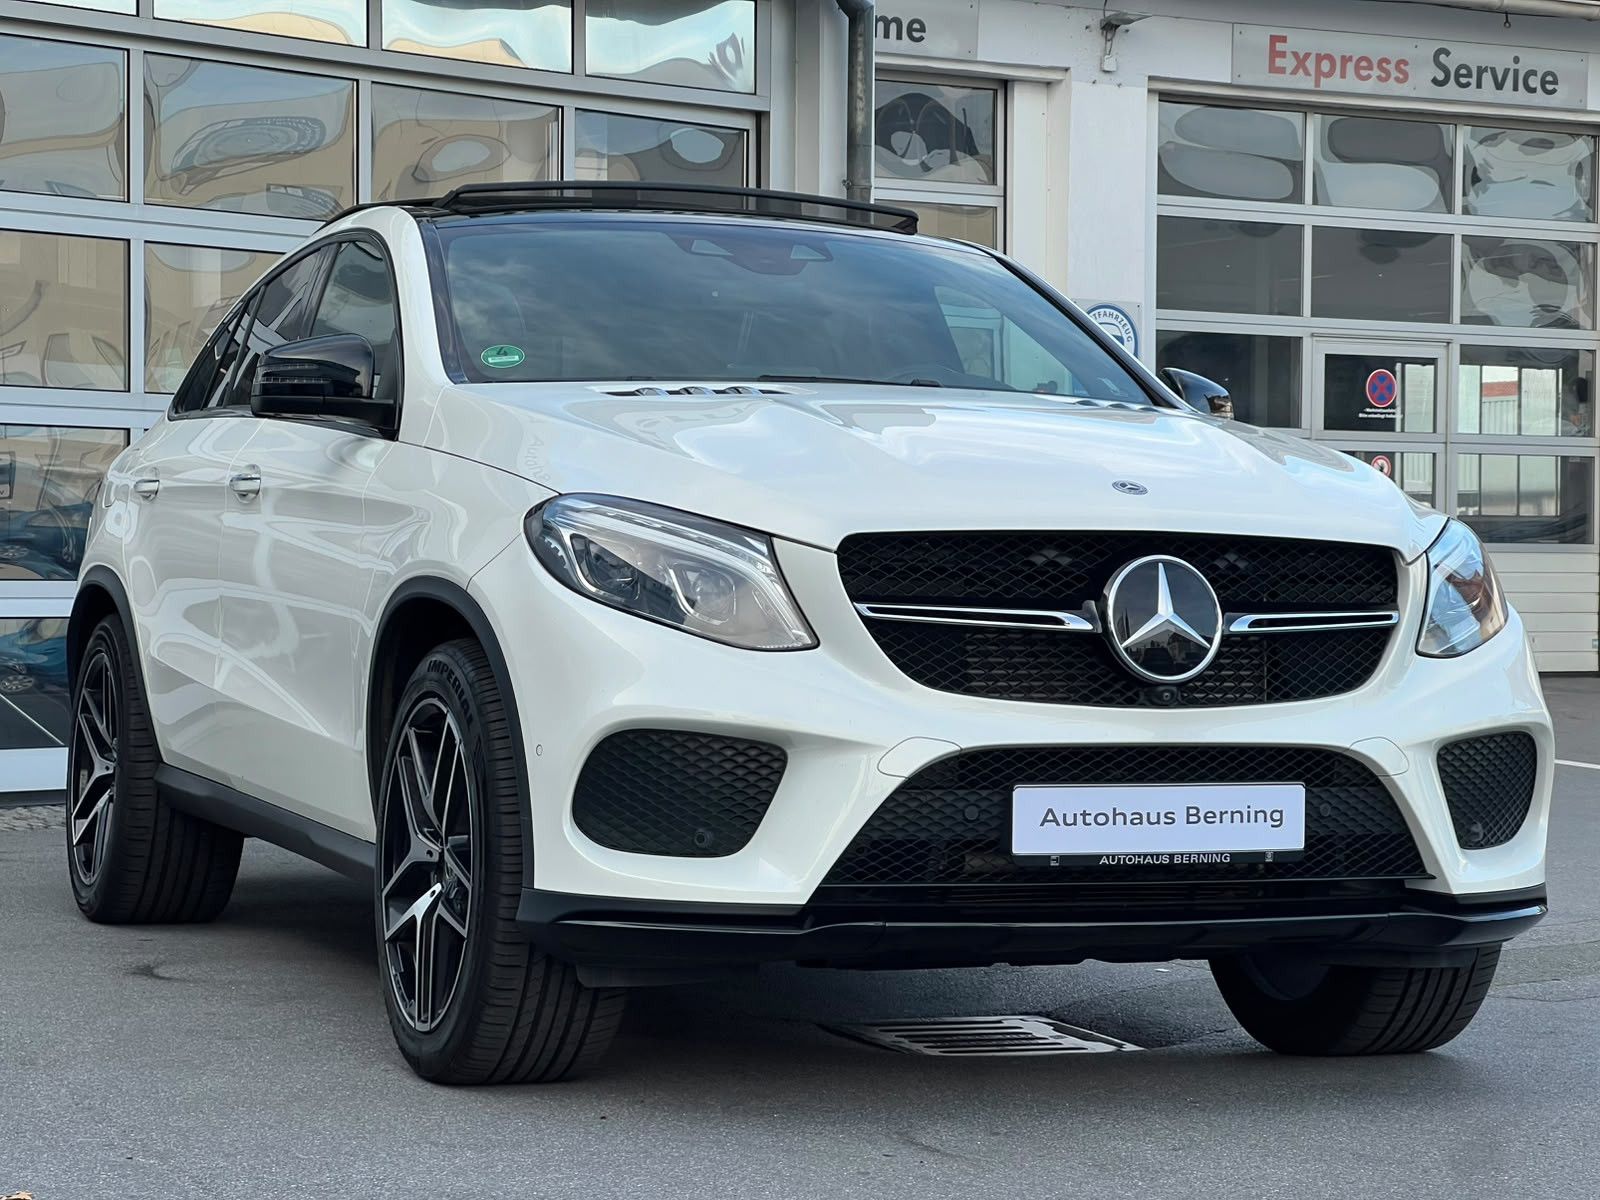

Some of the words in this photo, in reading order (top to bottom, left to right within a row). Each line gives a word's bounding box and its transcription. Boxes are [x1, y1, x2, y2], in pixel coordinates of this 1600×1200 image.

[1268, 34, 1410, 88] Express
[1430, 47, 1559, 96] Service
[1039, 806, 1176, 827] Autohaus
[1185, 804, 1284, 829] Berning
[1099, 854, 1170, 865] AUTOHAUS
[1173, 853, 1231, 864] BERNING
